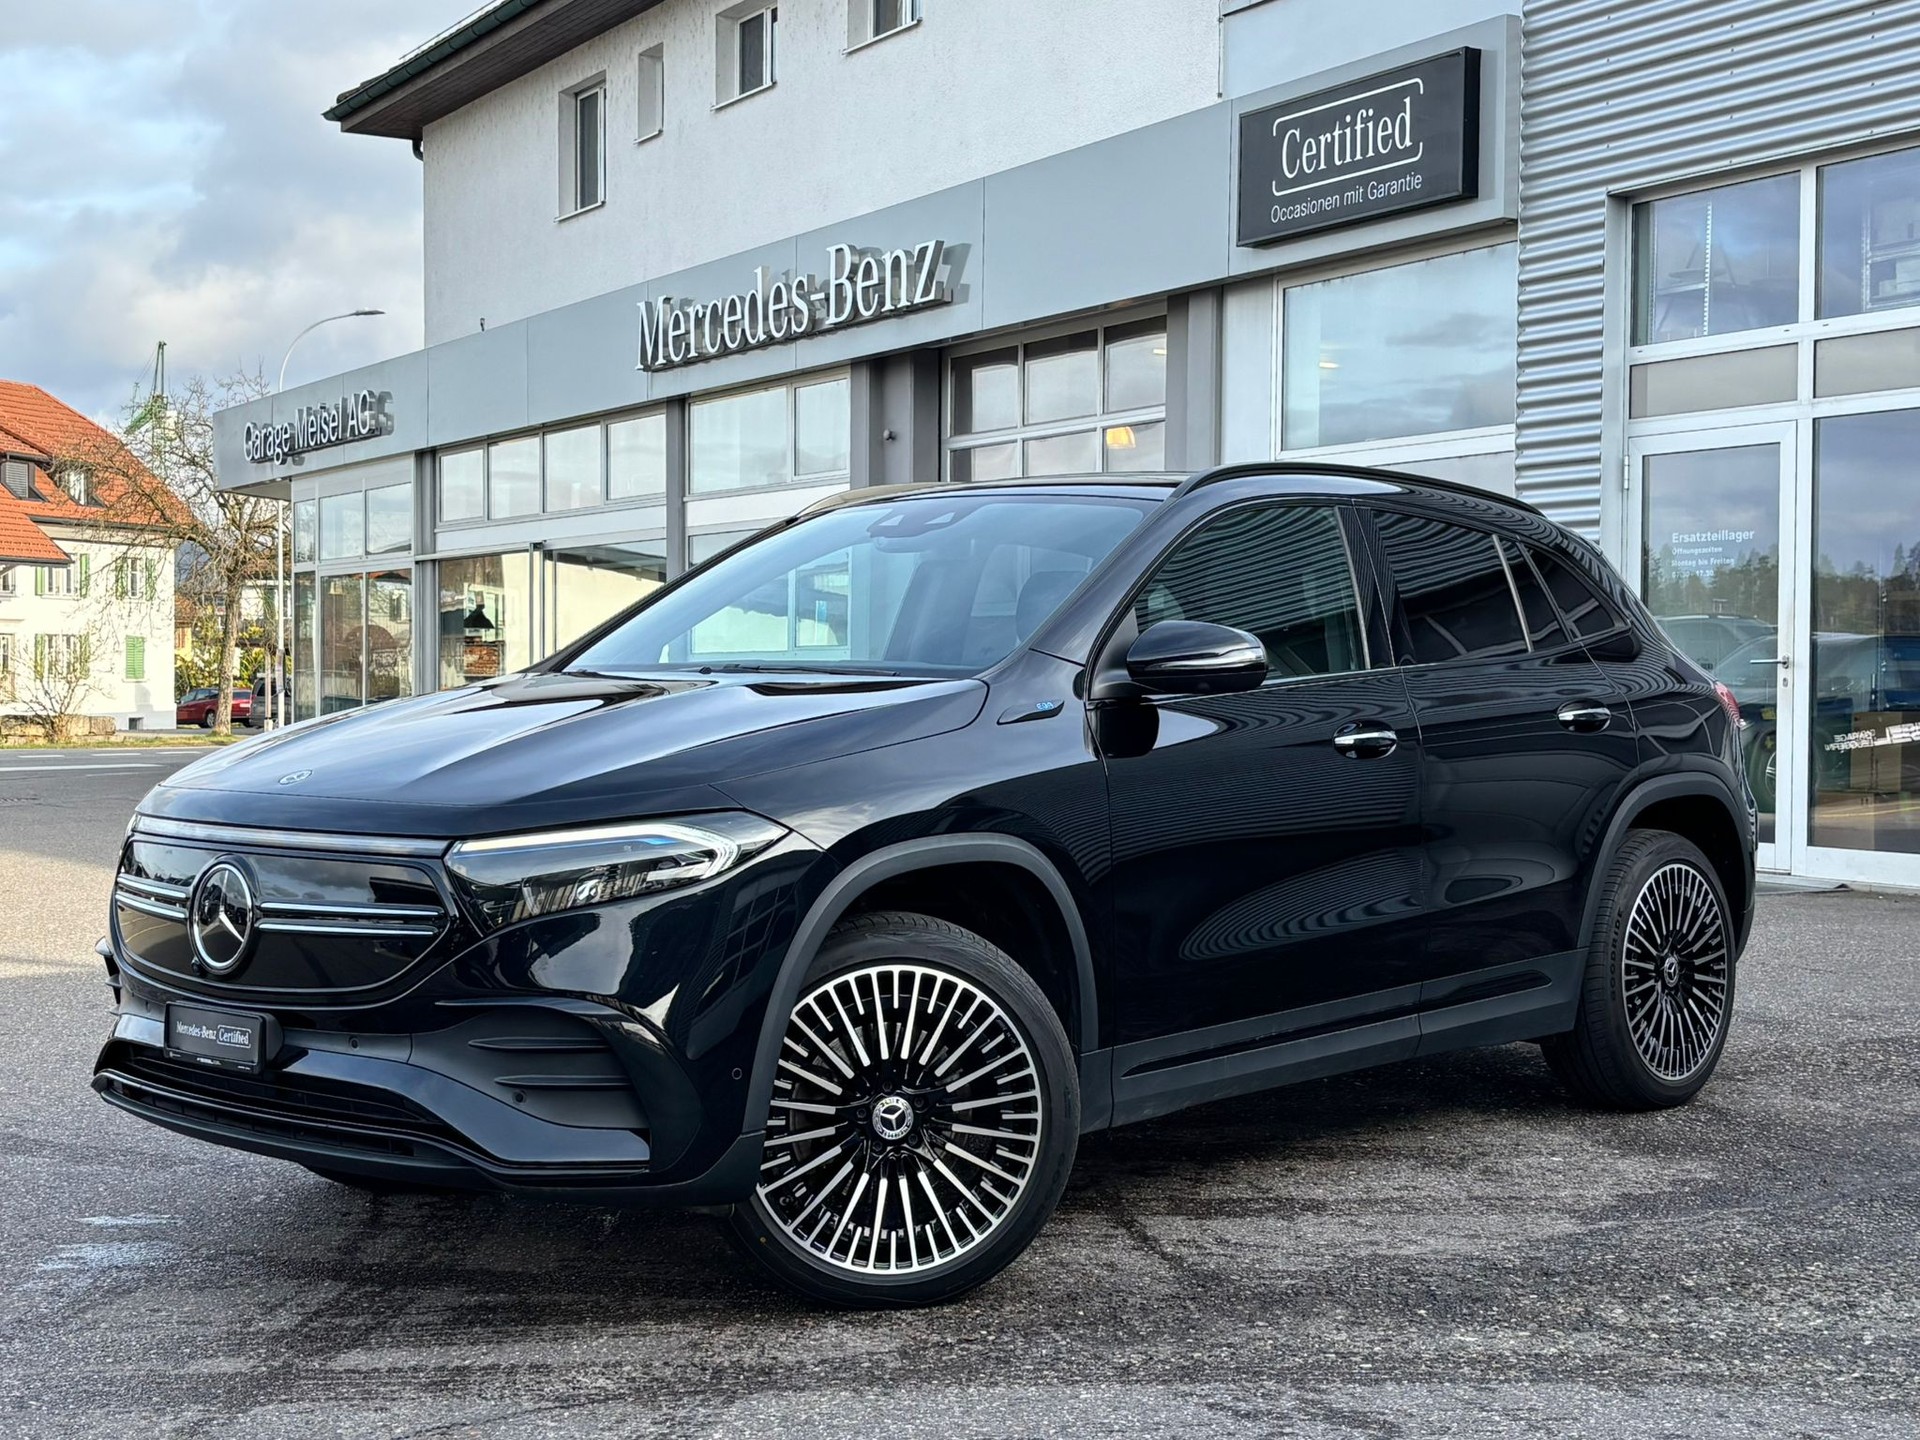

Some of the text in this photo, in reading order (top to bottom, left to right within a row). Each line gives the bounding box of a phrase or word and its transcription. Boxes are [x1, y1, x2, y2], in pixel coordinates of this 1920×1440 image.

[1282, 96, 1413, 179] Certified
[1270, 171, 1422, 224] Occasionen mit Garantie
[635, 239, 946, 371] Mercedes-Benz
[243, 389, 372, 466] Garage Meisel AG
[1671, 529, 1755, 543] Ersatzteillager
[176, 1021, 249, 1045] Mercedes-Benz Certified
